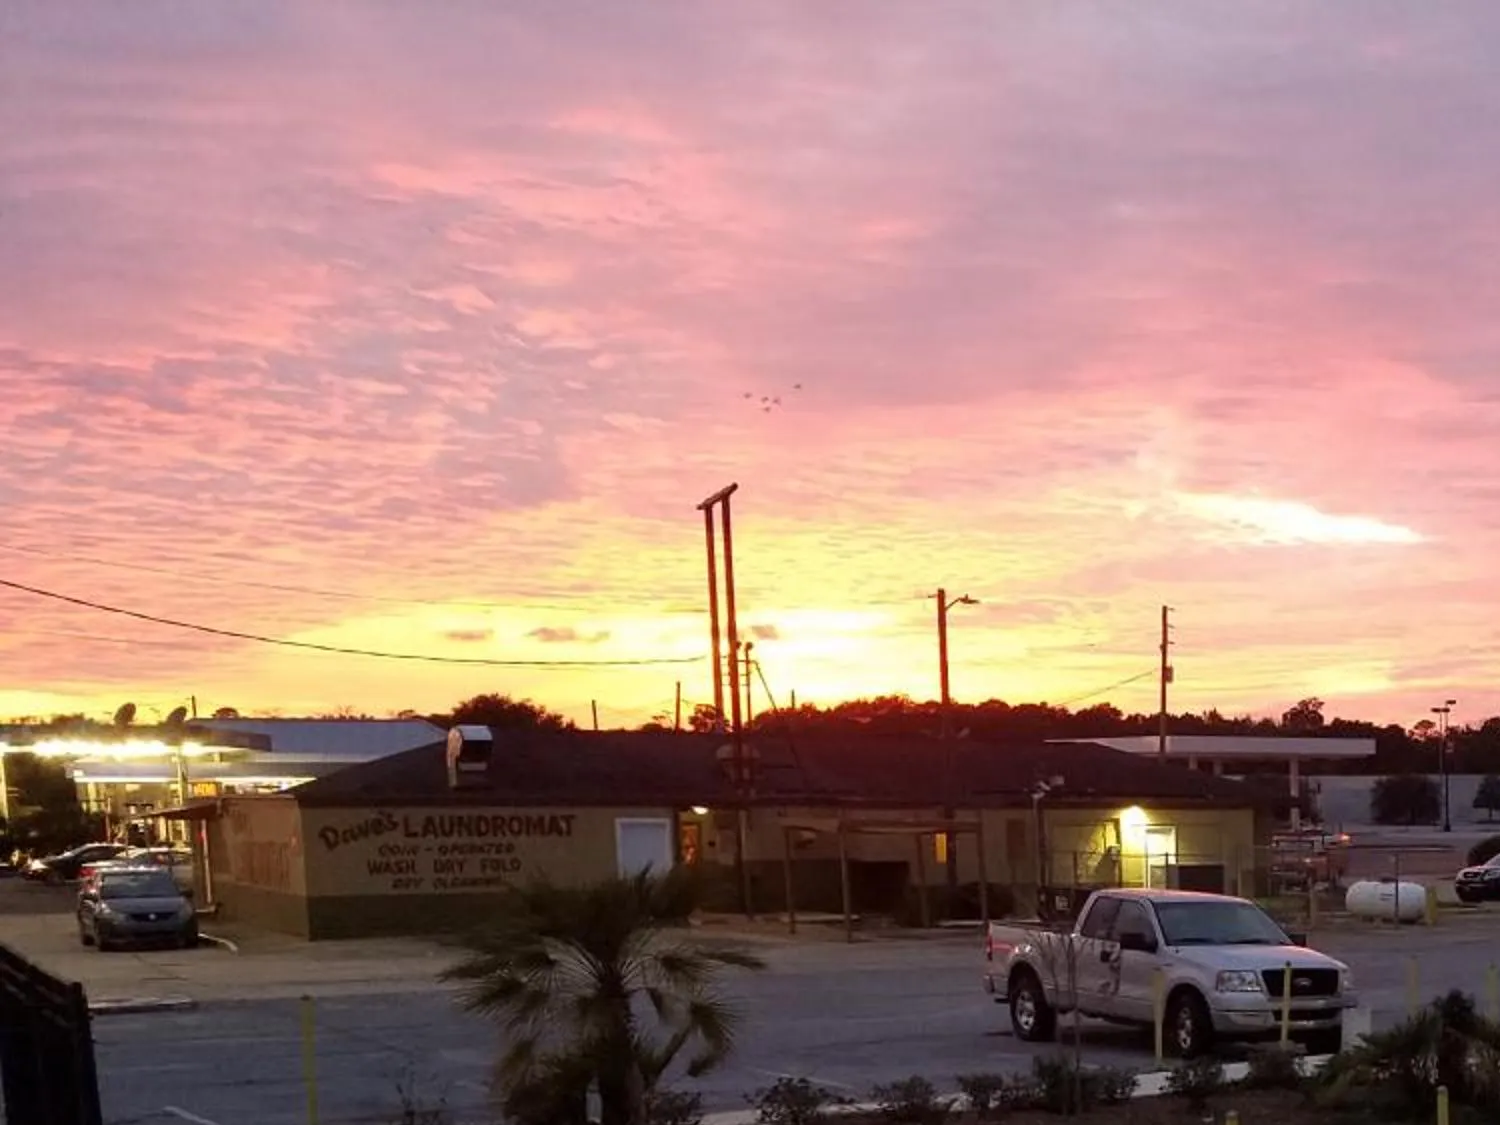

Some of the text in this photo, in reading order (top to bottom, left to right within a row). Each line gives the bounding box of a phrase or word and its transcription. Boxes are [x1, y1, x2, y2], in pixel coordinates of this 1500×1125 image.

[318, 811, 577, 851] Dave's LAUNDROMAT
[377, 844, 420, 857] COIN
[366, 858, 523, 877] WASH DRY FOLD
